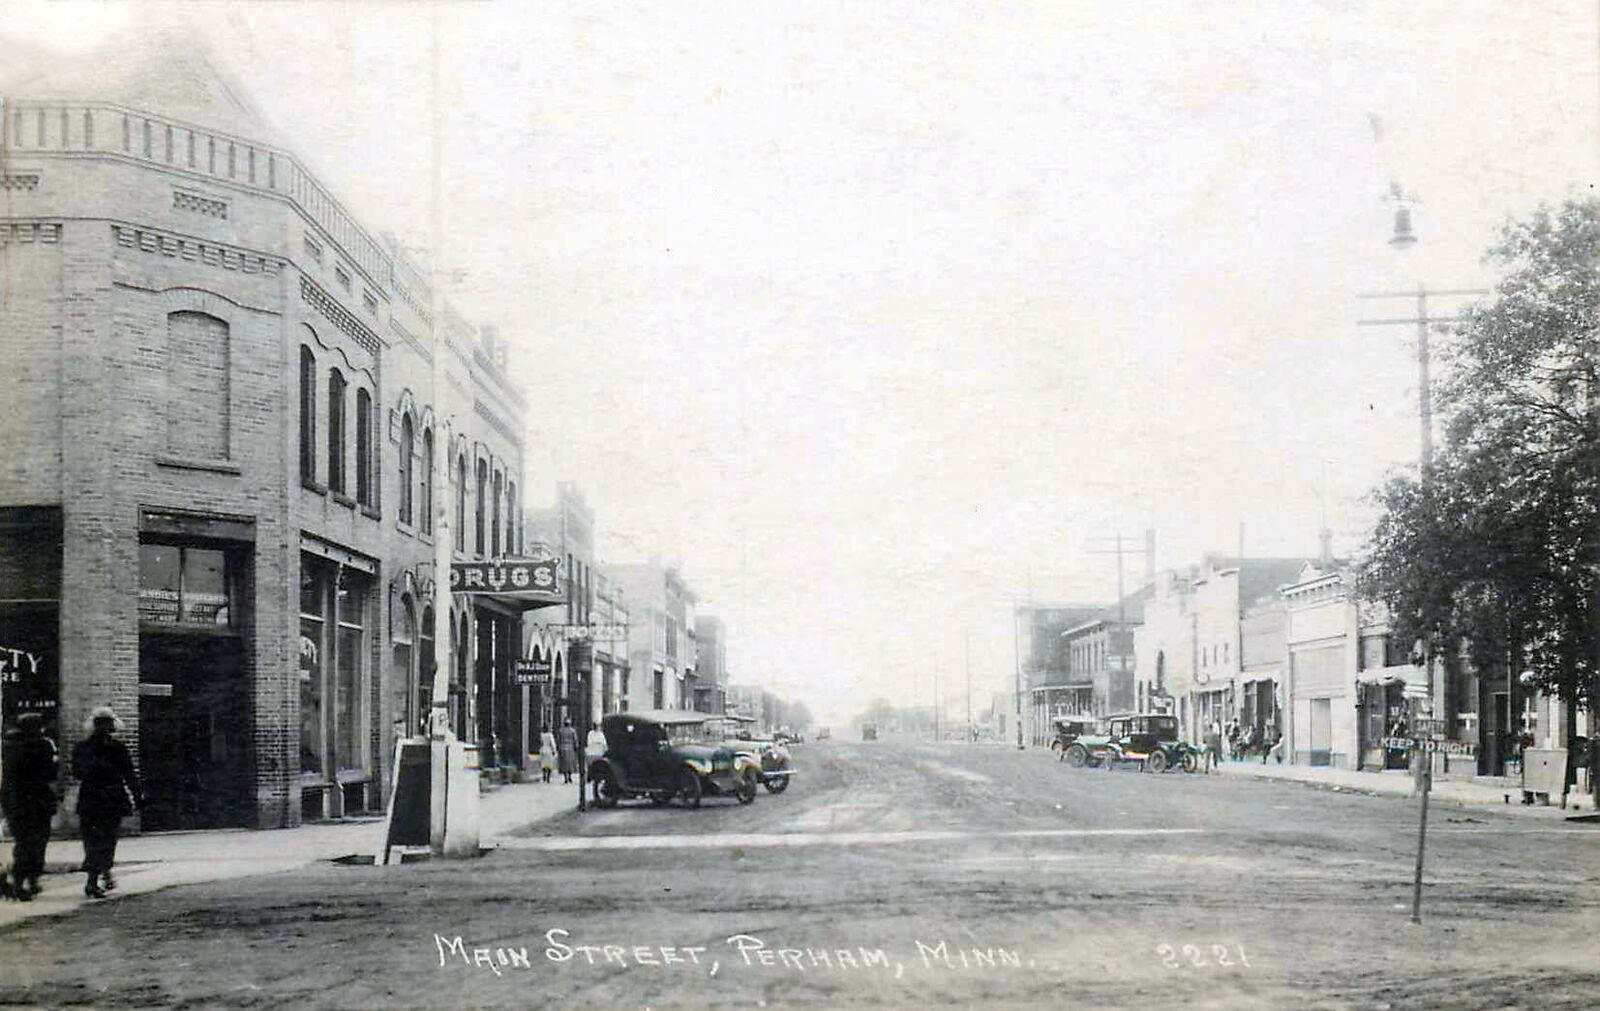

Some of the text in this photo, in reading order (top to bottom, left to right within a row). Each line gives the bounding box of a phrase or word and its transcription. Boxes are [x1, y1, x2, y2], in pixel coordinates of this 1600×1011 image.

[0, 646, 43, 674] TY
[517, 674, 549, 682] DENTIST
[1380, 737, 1475, 755] KEEP TO RIGHT
